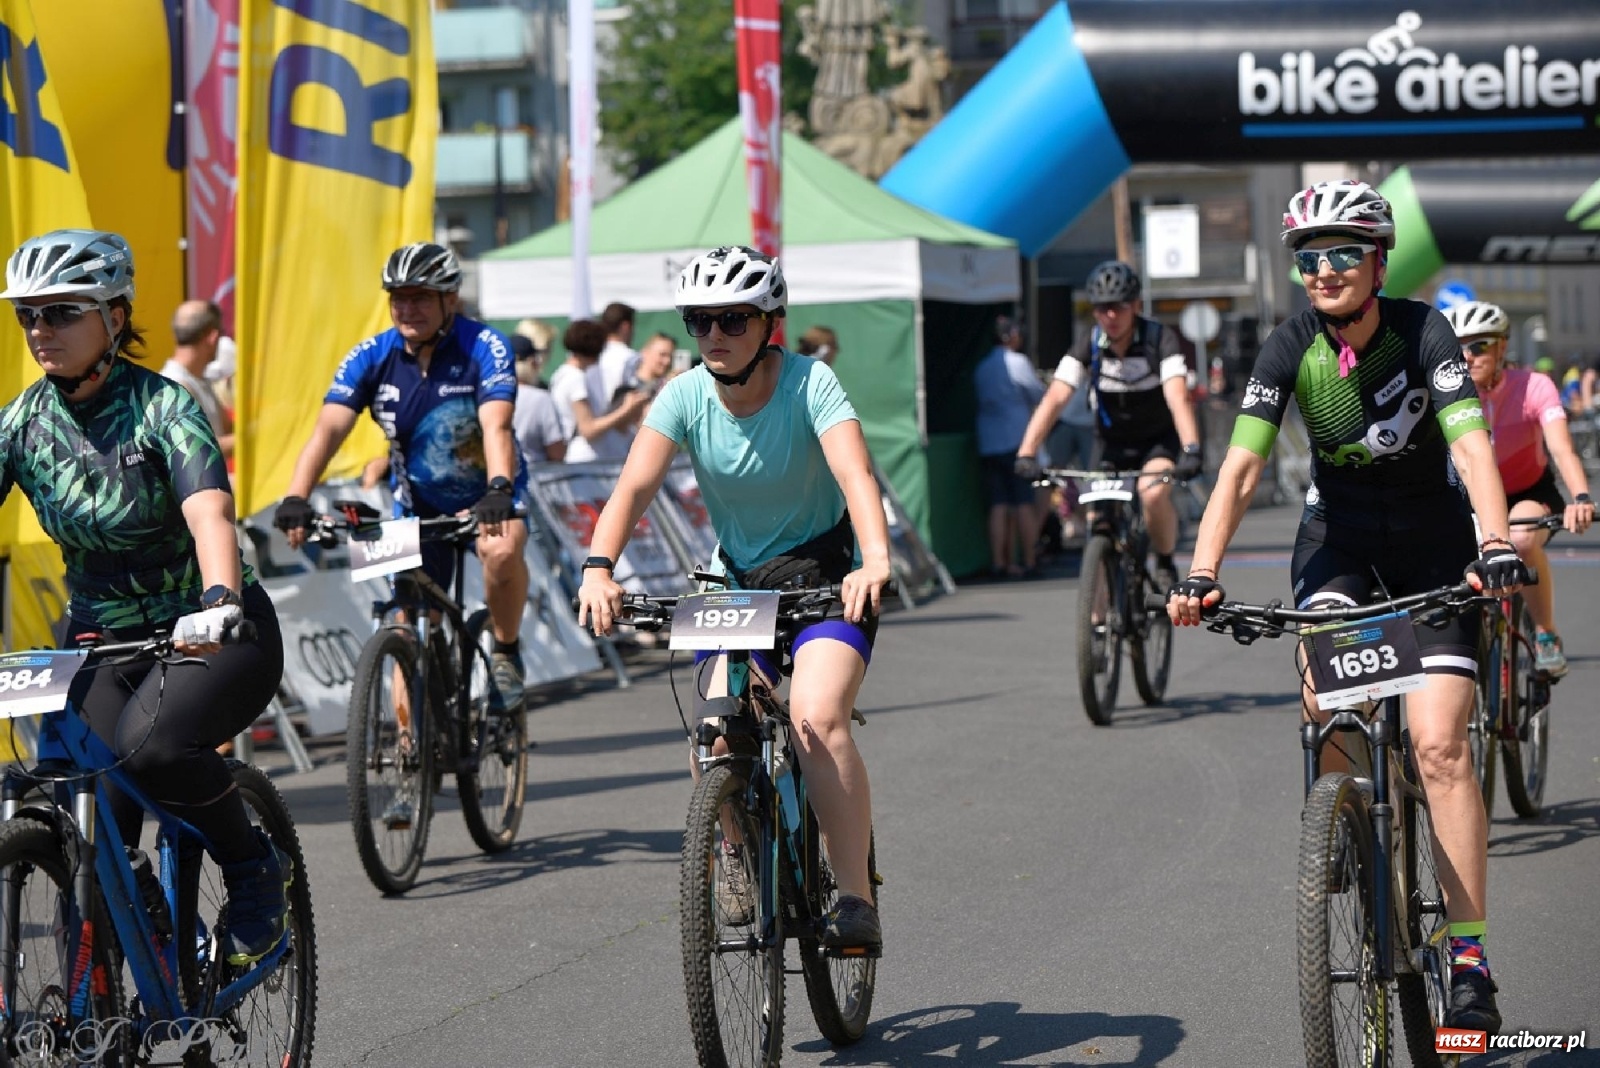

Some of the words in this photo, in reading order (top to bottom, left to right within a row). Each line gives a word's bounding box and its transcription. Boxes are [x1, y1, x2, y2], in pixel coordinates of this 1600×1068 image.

[1238, 50, 1379, 115] bike
[1395, 45, 1600, 112] atelier
[693, 608, 758, 628] 1997
[1329, 644, 1399, 679] 1693
